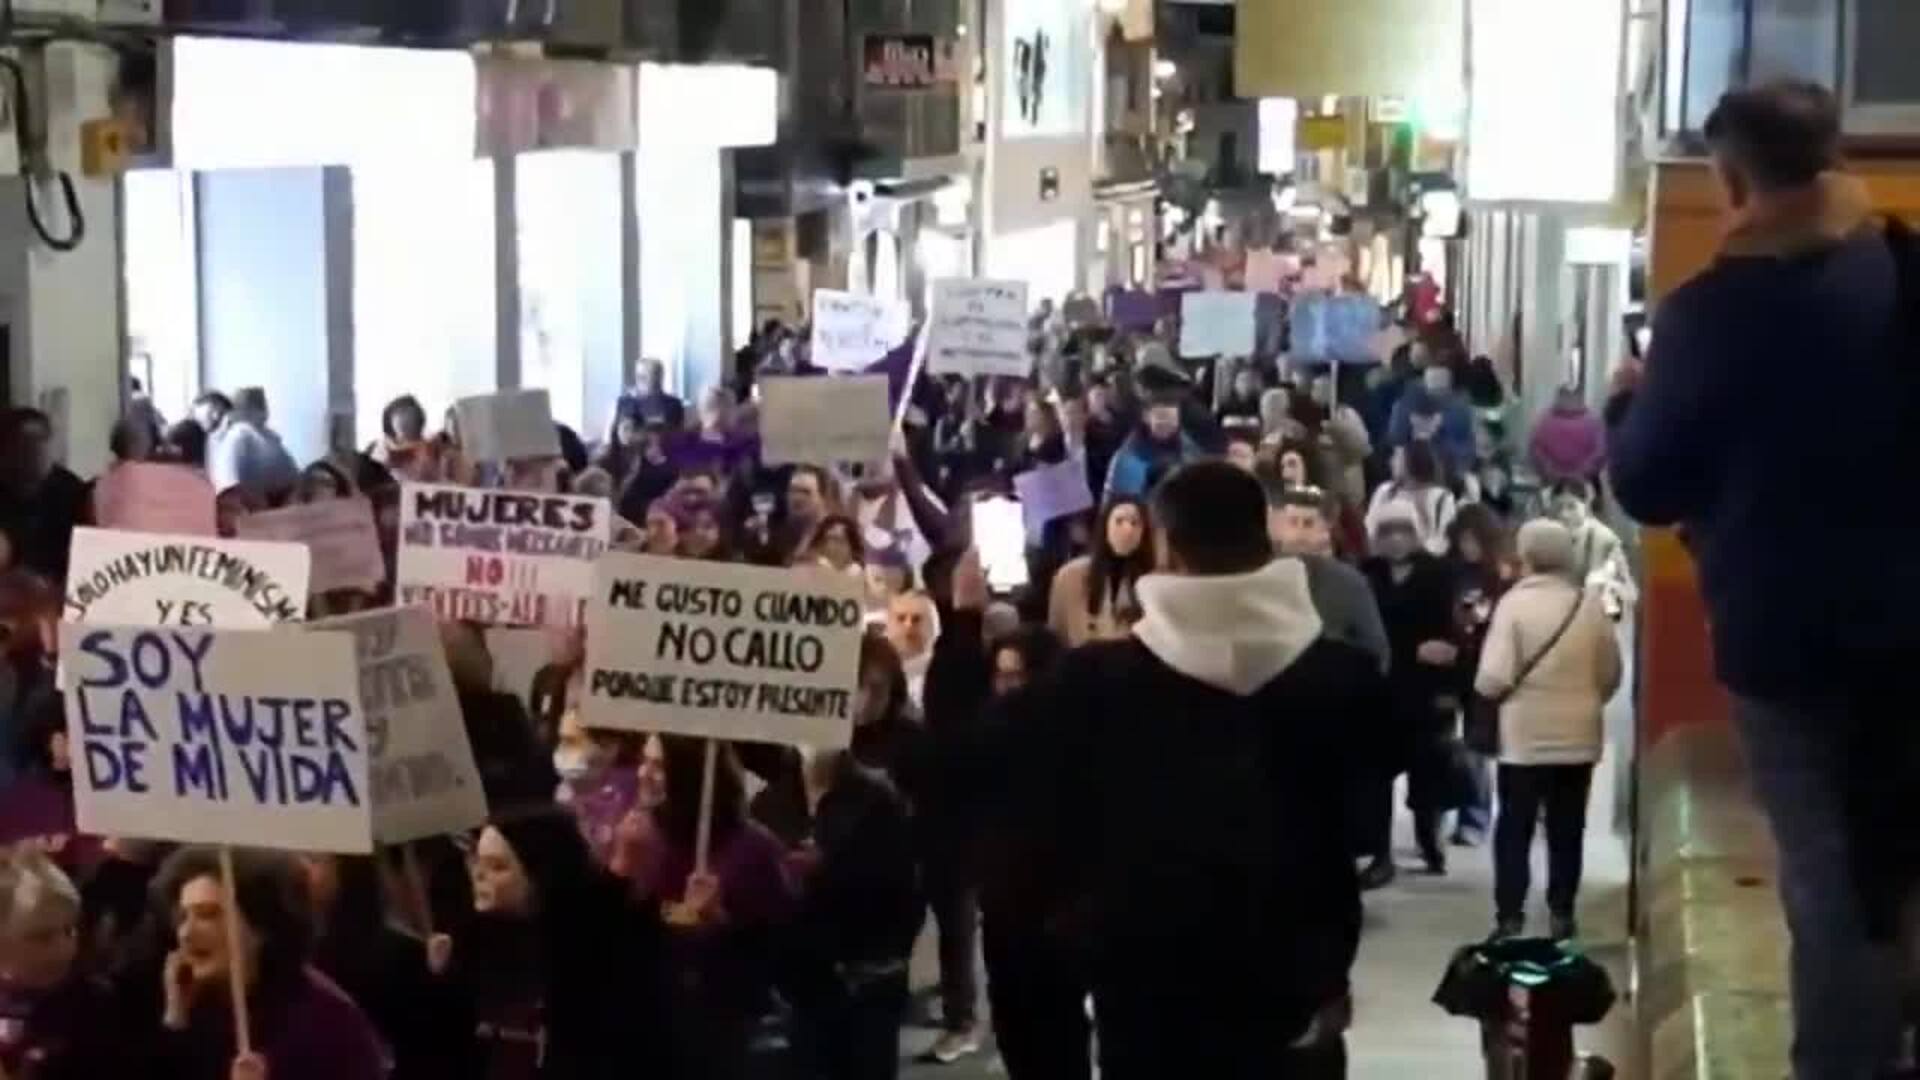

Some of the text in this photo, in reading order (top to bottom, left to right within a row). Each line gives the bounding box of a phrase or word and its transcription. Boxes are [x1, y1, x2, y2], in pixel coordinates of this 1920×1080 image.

[415, 490, 595, 532] MUJERES
[608, 578, 860, 628] ME GUSTO CUANDO
[79, 630, 214, 691] SOY
[656, 620, 825, 673] NO CALLO
[77, 685, 160, 741] LA
[176, 692, 359, 751] MUJER
[590, 668, 853, 719] PORQUE ESTOY PRESENTE
[83, 740, 149, 793] DE
[173, 743, 229, 801] MI
[236, 749, 361, 807] VIDA
